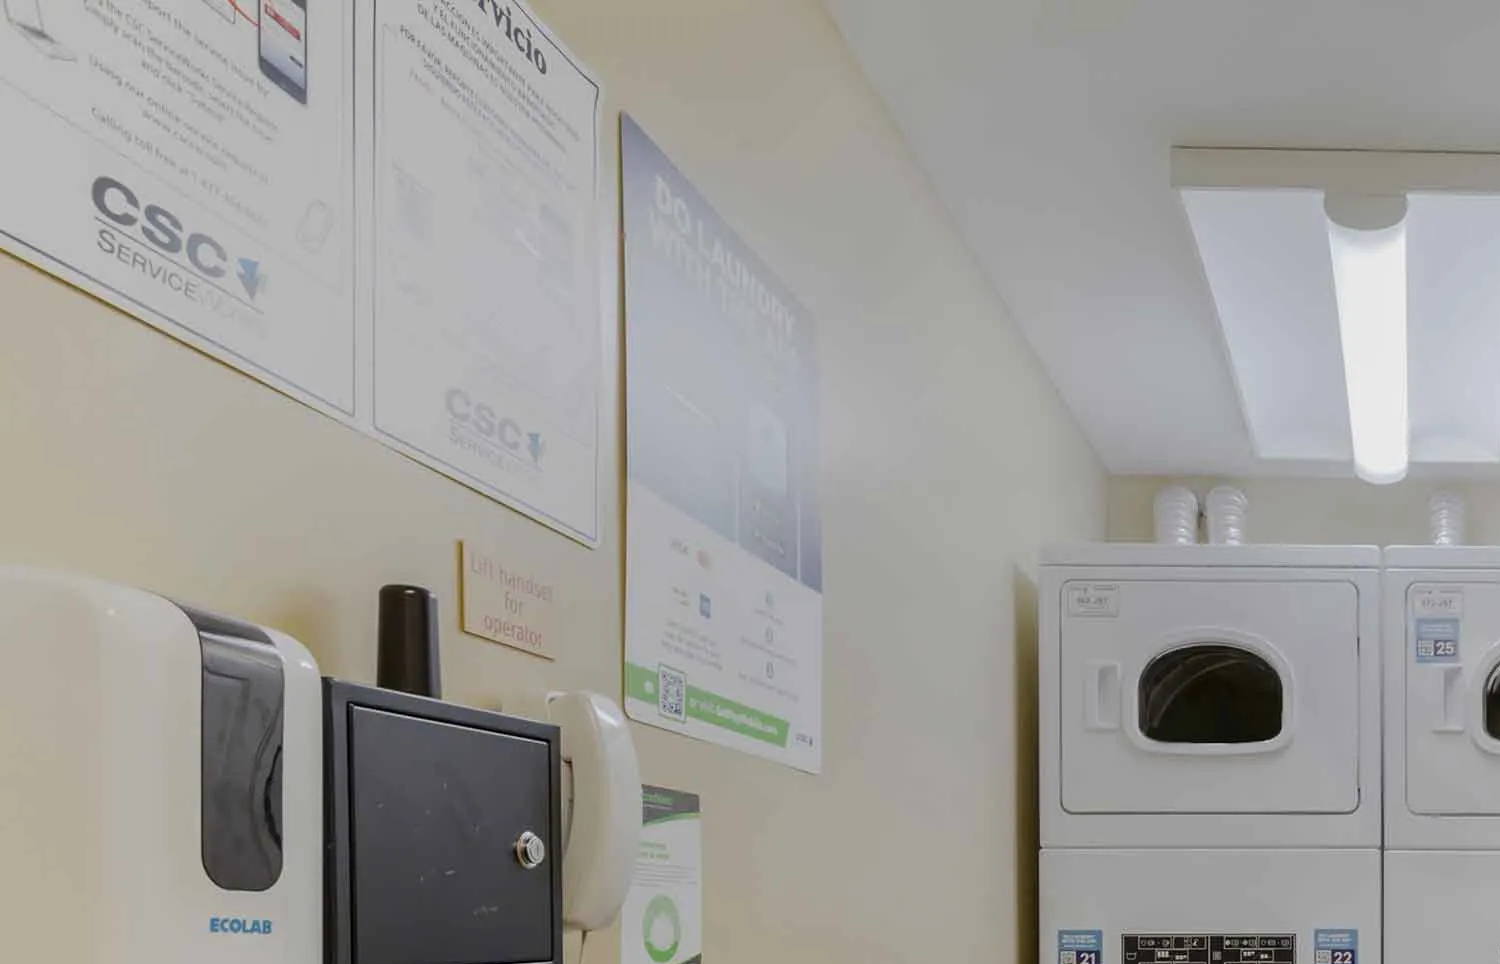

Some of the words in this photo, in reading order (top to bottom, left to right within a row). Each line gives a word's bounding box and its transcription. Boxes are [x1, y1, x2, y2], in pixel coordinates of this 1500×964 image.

[91, 175, 228, 279] CSC
[444, 386, 523, 453] CSC
[499, 564, 553, 605] handset
[504, 590, 524, 616] for
[483, 613, 543, 648] operator
[1435, 640, 1454, 656] 25
[209, 916, 273, 935] ECOLAB
[1333, 951, 1353, 964] 22
